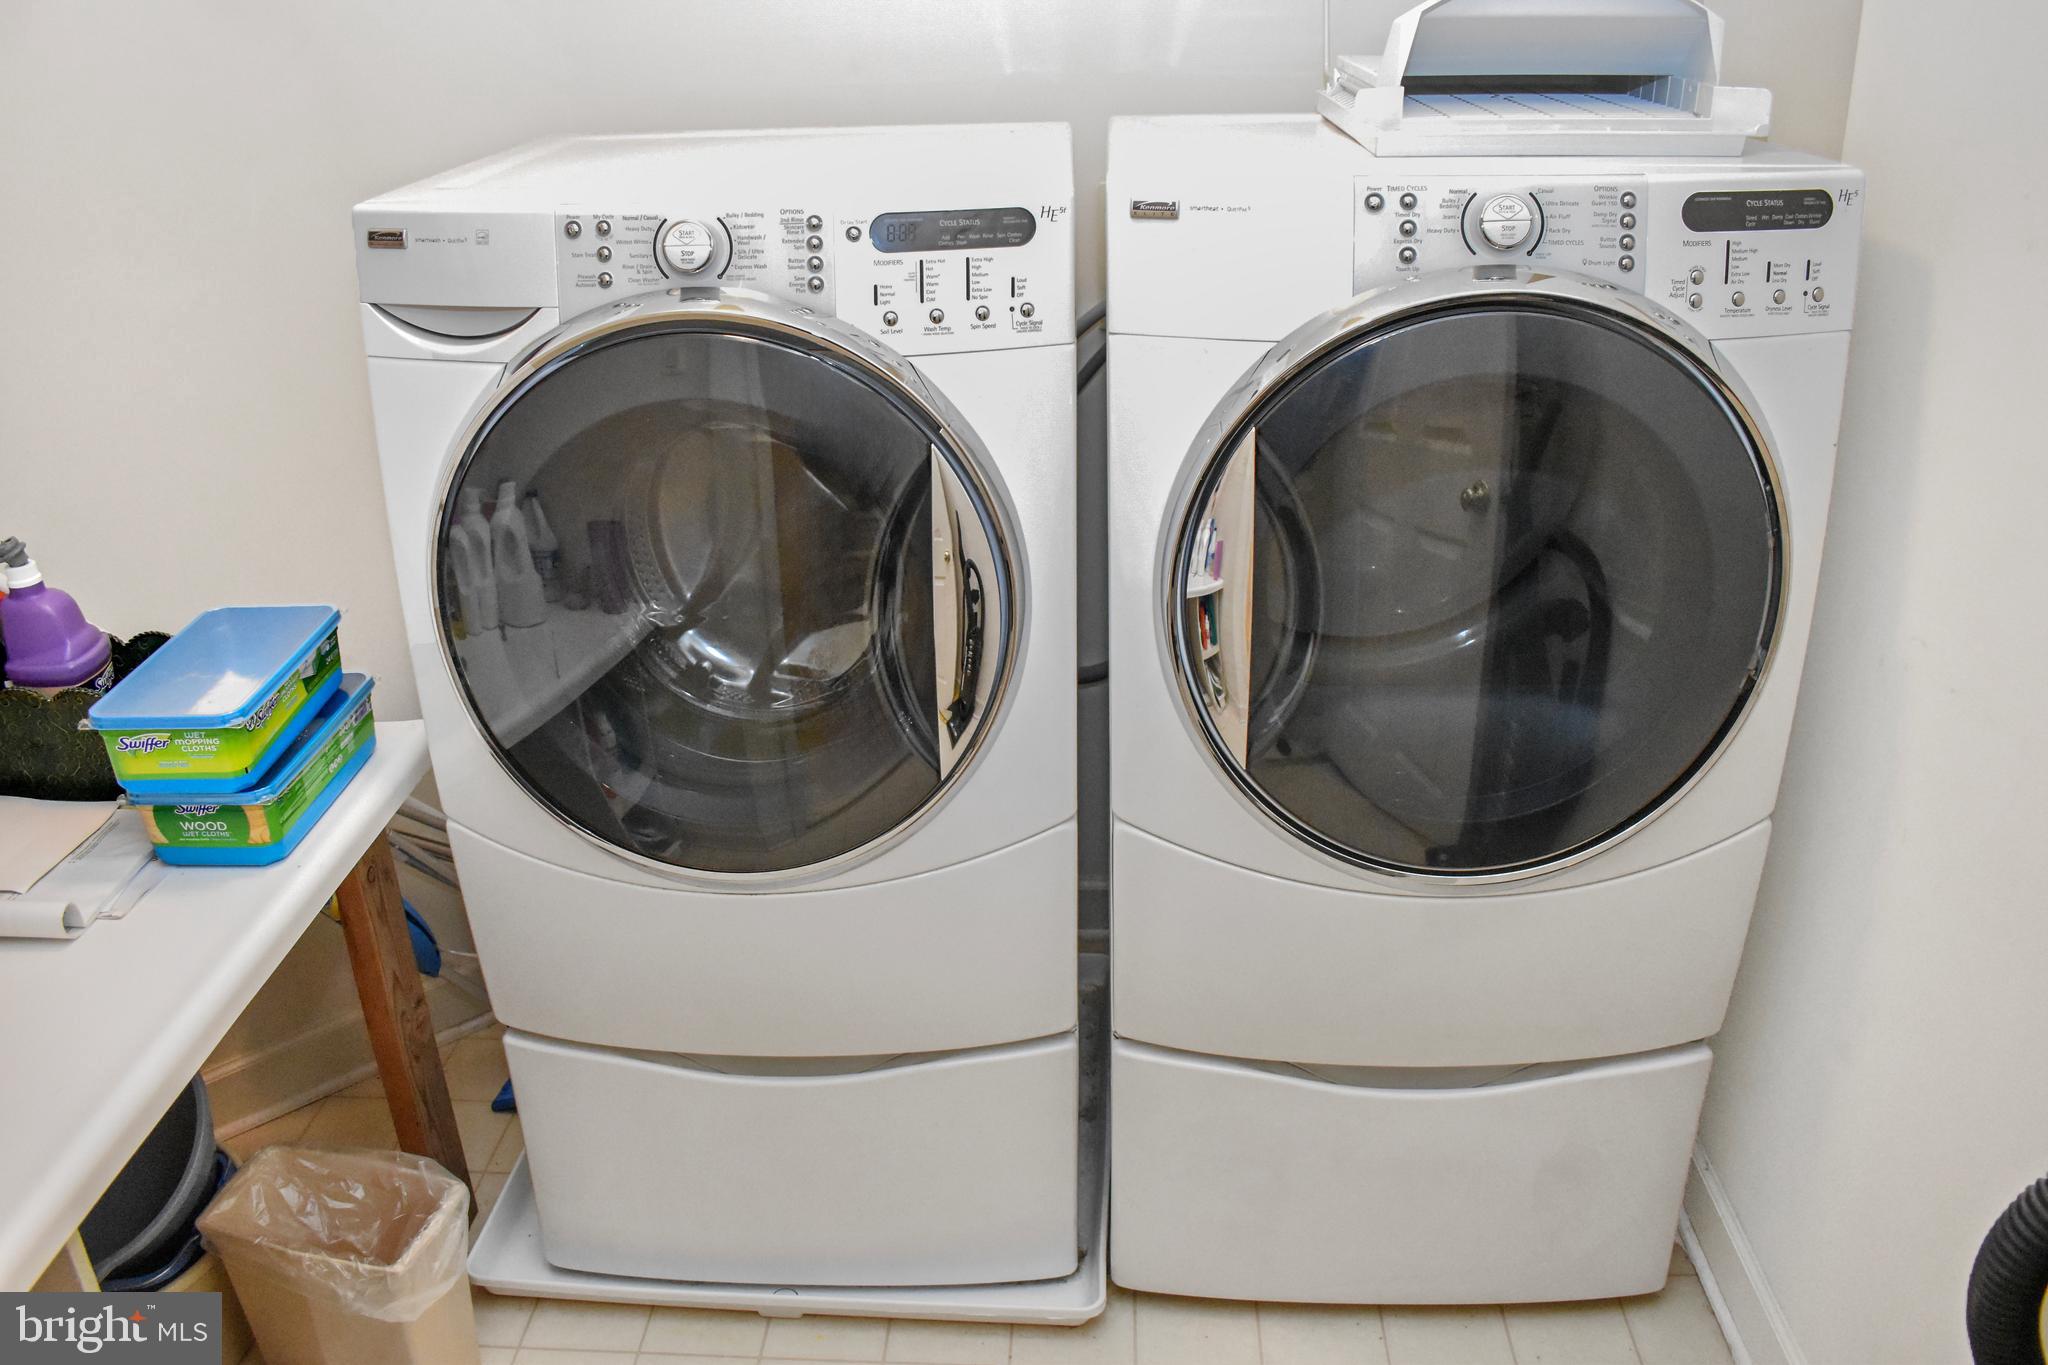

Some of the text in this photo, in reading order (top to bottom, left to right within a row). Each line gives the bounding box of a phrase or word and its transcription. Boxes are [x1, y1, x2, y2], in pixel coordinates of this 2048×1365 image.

[117, 737, 172, 752] Swiffer
[175, 805, 218, 815] Swiffer
[180, 822, 227, 830] WOOD
